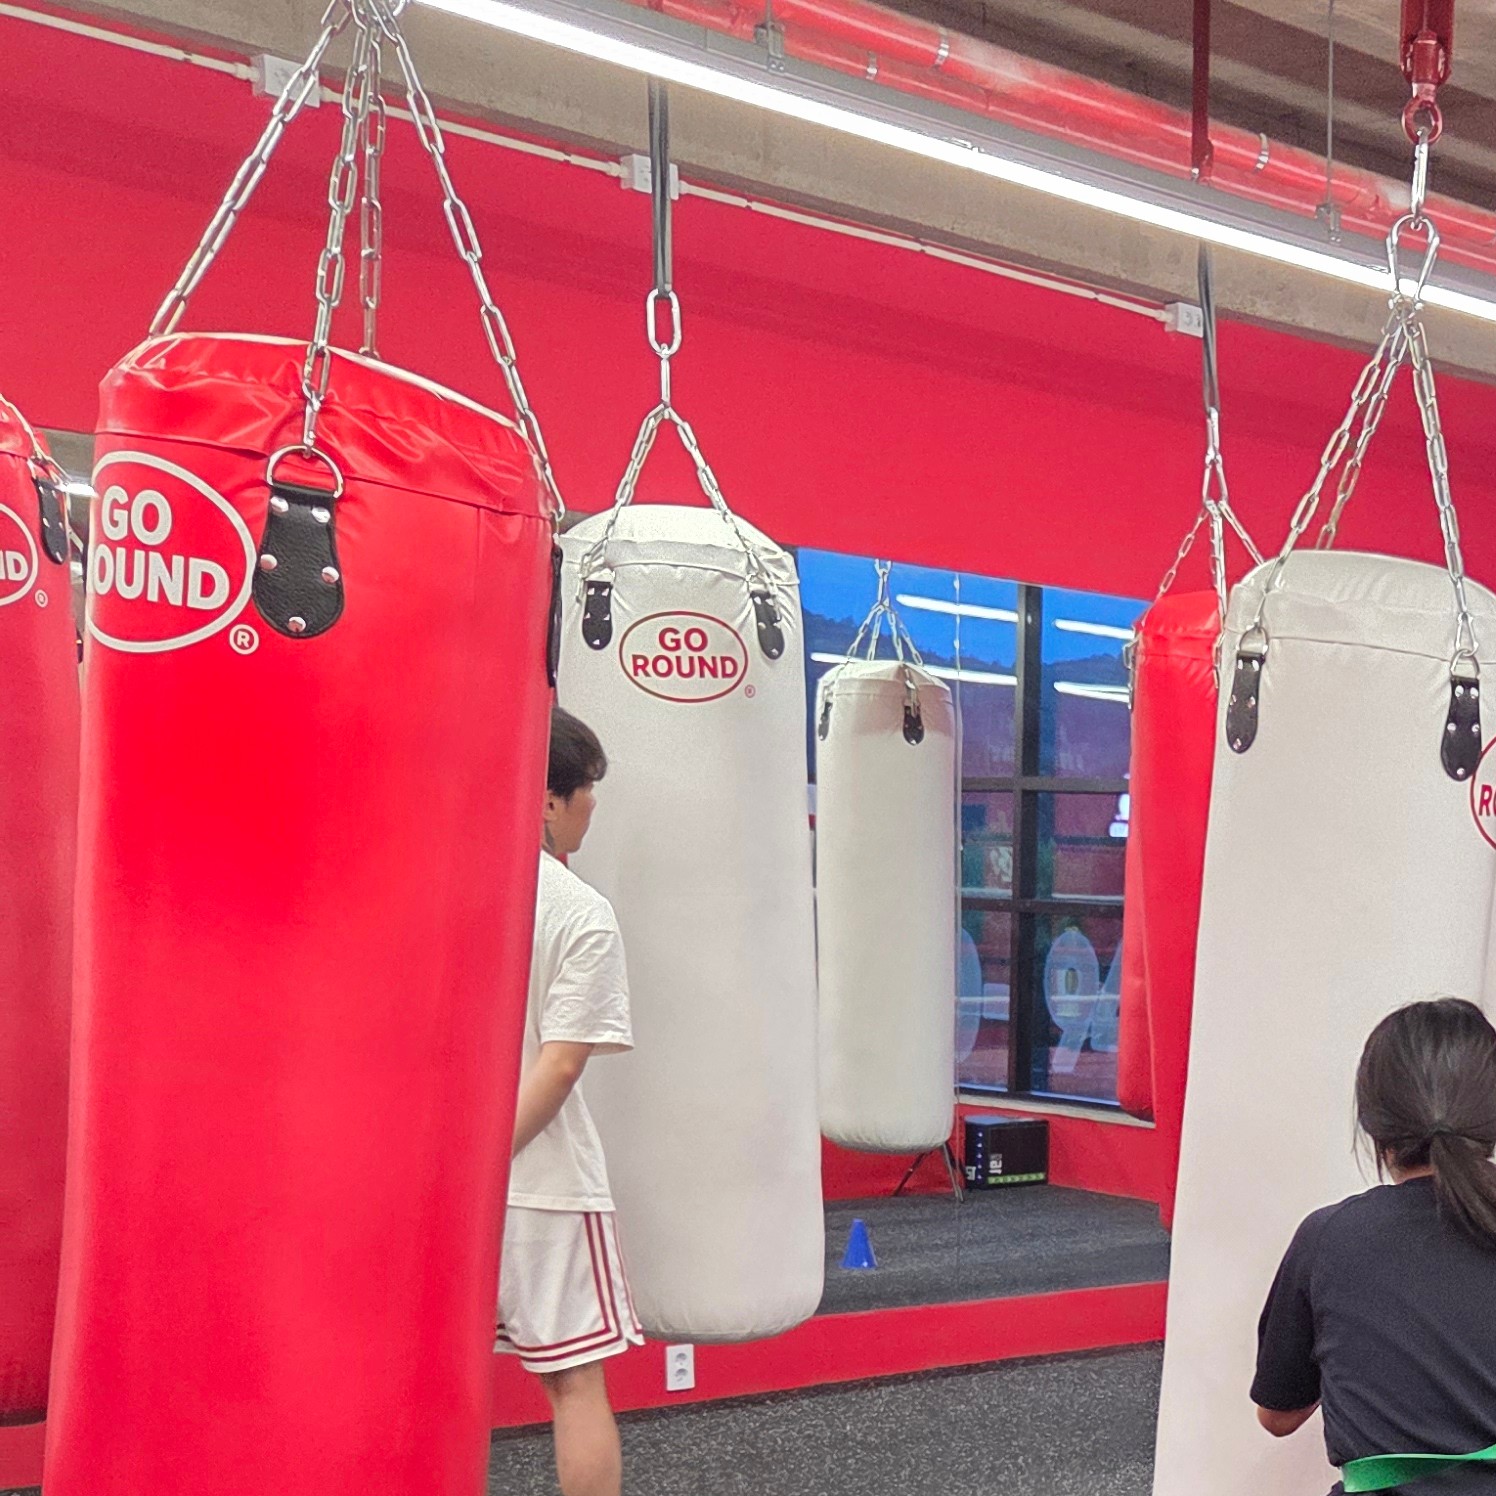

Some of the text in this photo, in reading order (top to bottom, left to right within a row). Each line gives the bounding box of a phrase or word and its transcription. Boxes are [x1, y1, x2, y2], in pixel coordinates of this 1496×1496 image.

[102, 485, 172, 546] GO
[93, 544, 230, 610] OUND
[658, 627, 708, 652] GO
[631, 654, 738, 679] ROUND
